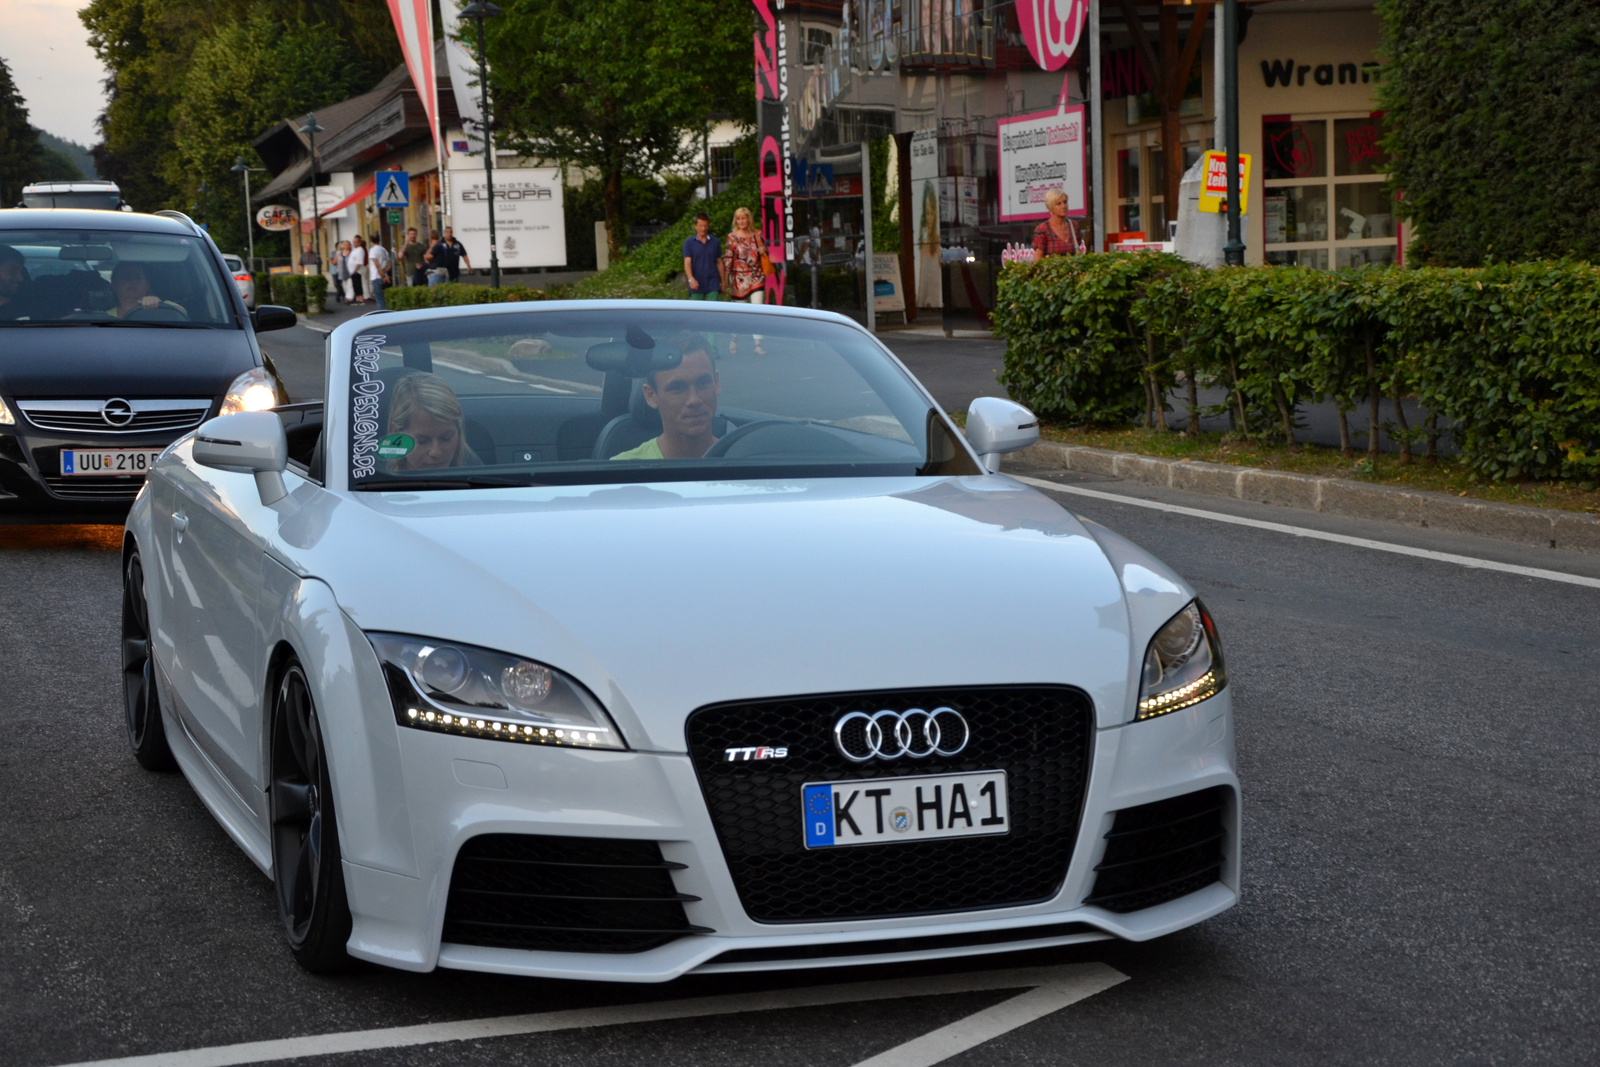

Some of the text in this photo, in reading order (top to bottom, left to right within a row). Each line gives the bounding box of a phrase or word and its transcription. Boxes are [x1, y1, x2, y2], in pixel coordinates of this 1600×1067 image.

[391, 436, 402, 447] 4
[80, 454, 101, 471] UU
[116, 453, 146, 470] 218
[816, 822, 826, 836] D
[833, 787, 891, 837] KT
